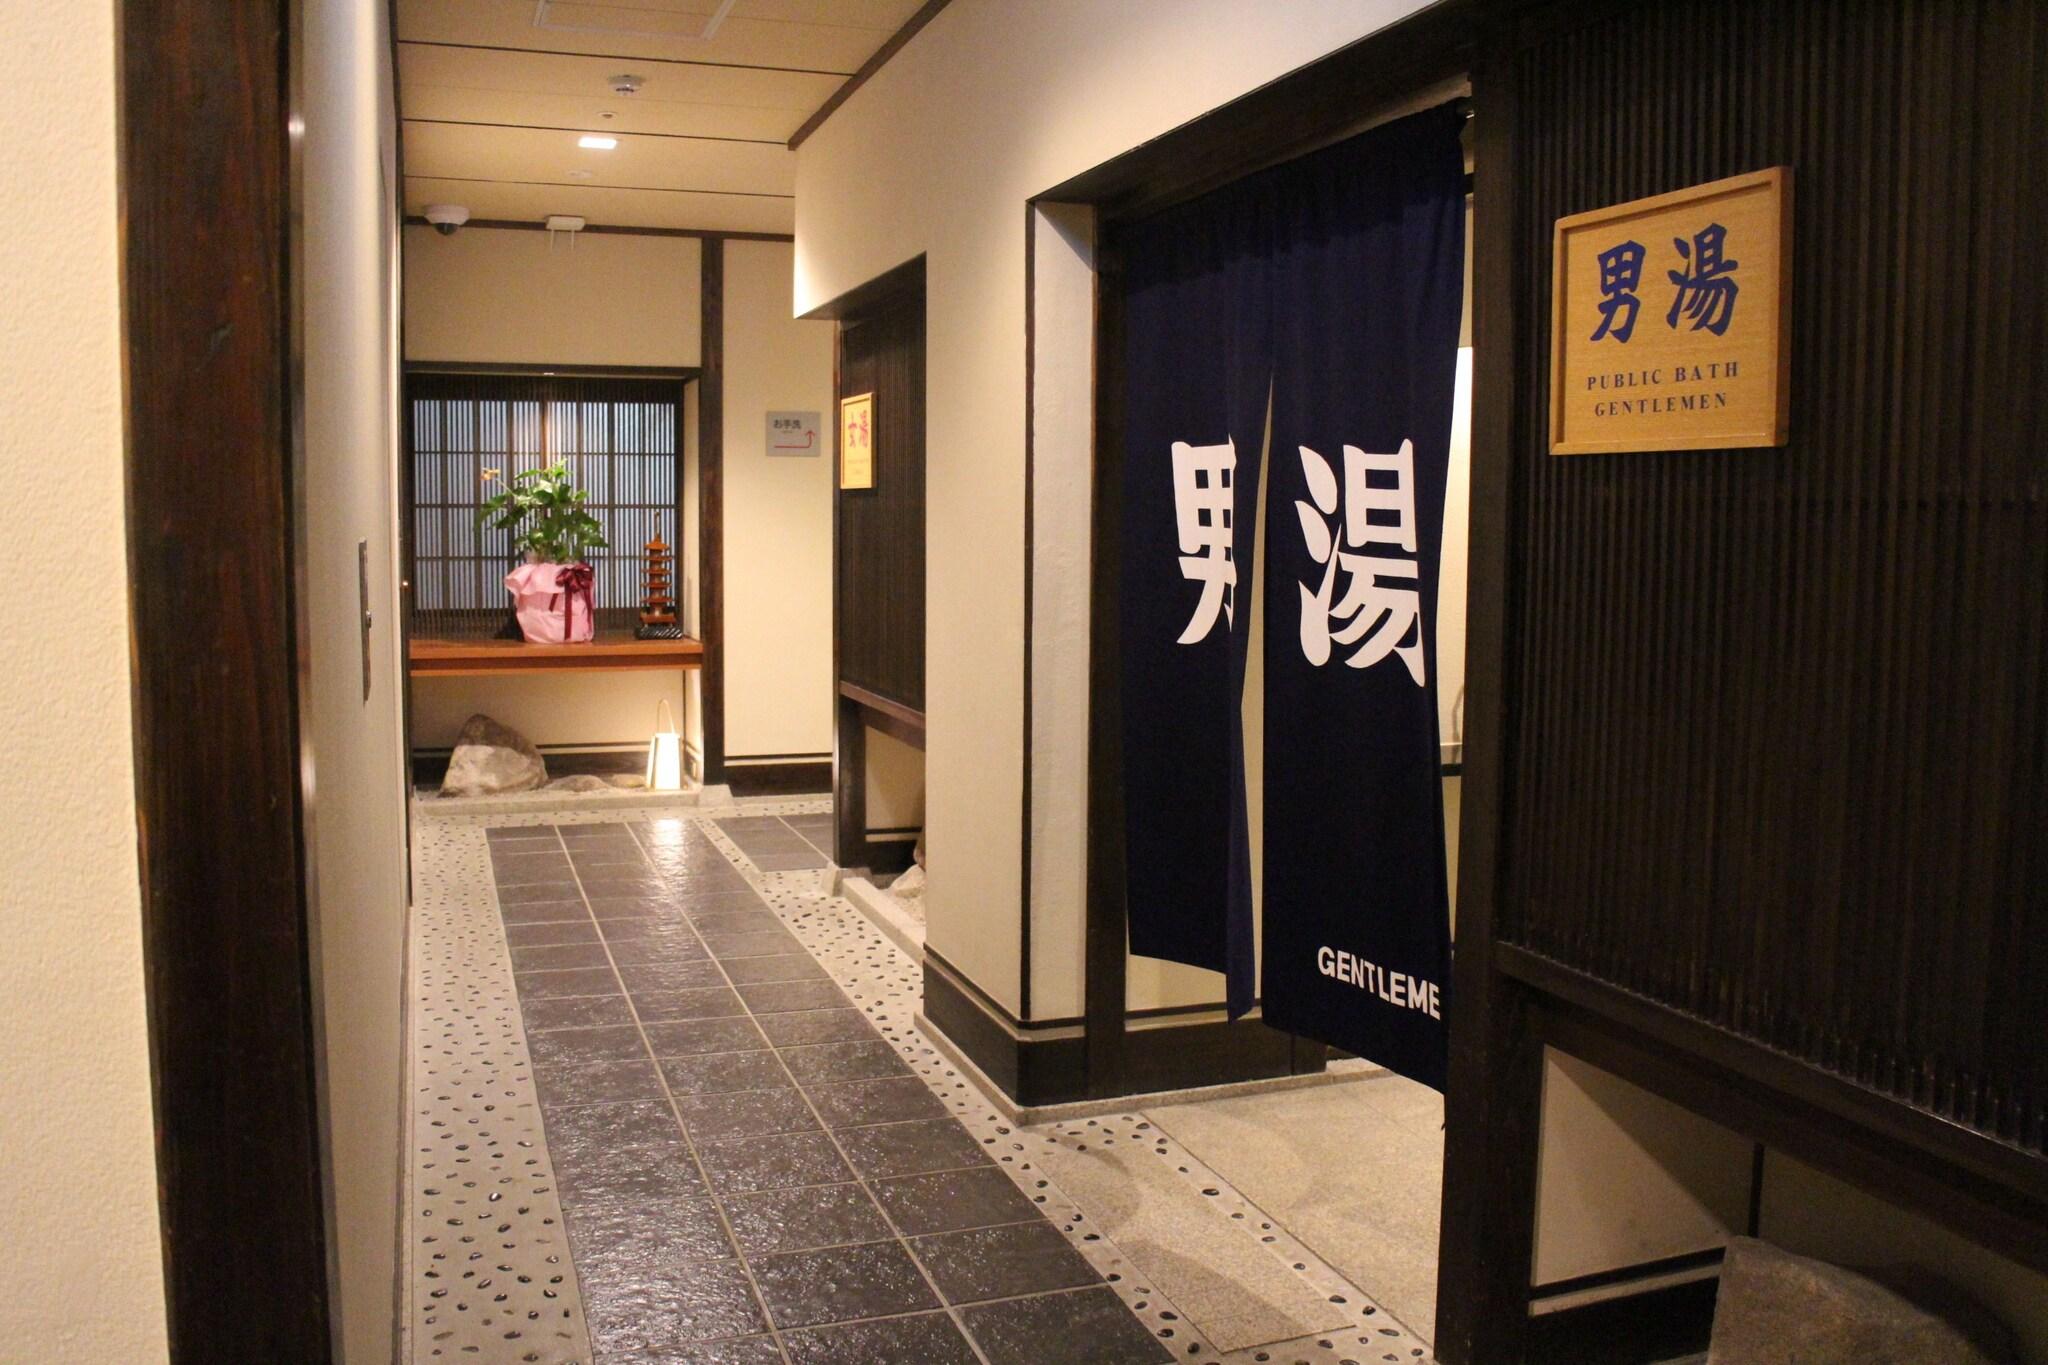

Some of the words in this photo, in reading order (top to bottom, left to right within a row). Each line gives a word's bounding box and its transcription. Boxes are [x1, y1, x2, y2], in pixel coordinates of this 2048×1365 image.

[1590, 223, 1739, 343] 男湯
[1587, 369, 1662, 391] PUBLIC
[1675, 361, 1739, 382] BATH
[1594, 393, 1727, 417] GENTLEMEN
